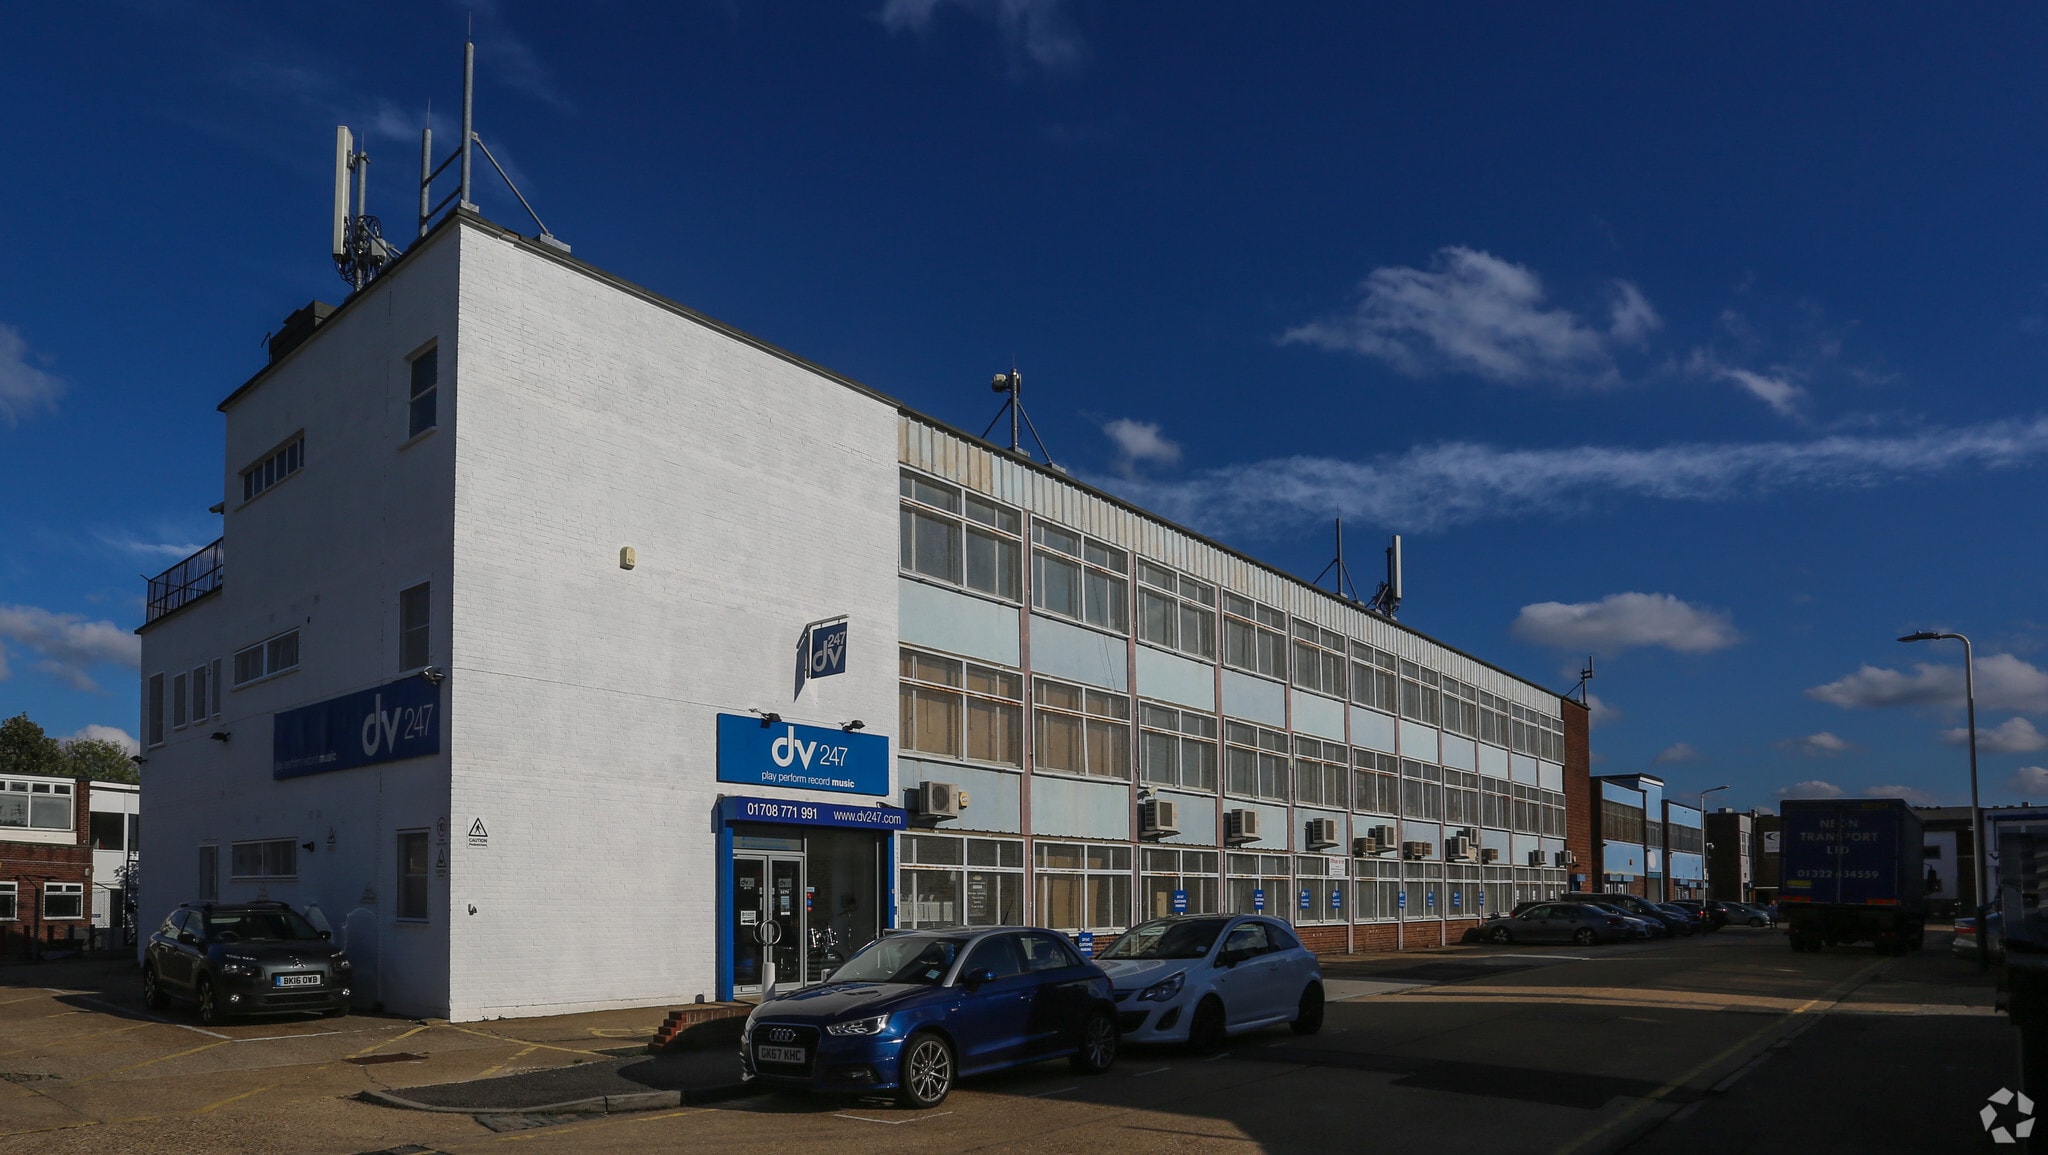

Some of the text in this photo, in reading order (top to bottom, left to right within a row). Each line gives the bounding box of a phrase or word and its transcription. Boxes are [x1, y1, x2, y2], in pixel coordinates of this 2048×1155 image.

[812, 631, 846, 673] dv 247
[362, 693, 434, 757] dv 247
[771, 725, 848, 771] dv 247
[761, 770, 855, 789] play perform record music
[747, 802, 902, 825] 01708 771 991 www.dv247.com
[1797, 869, 1833, 879] 01322
[283, 975, 318, 985] BK16 OWB
[761, 1047, 802, 1062] GK67 KHC
